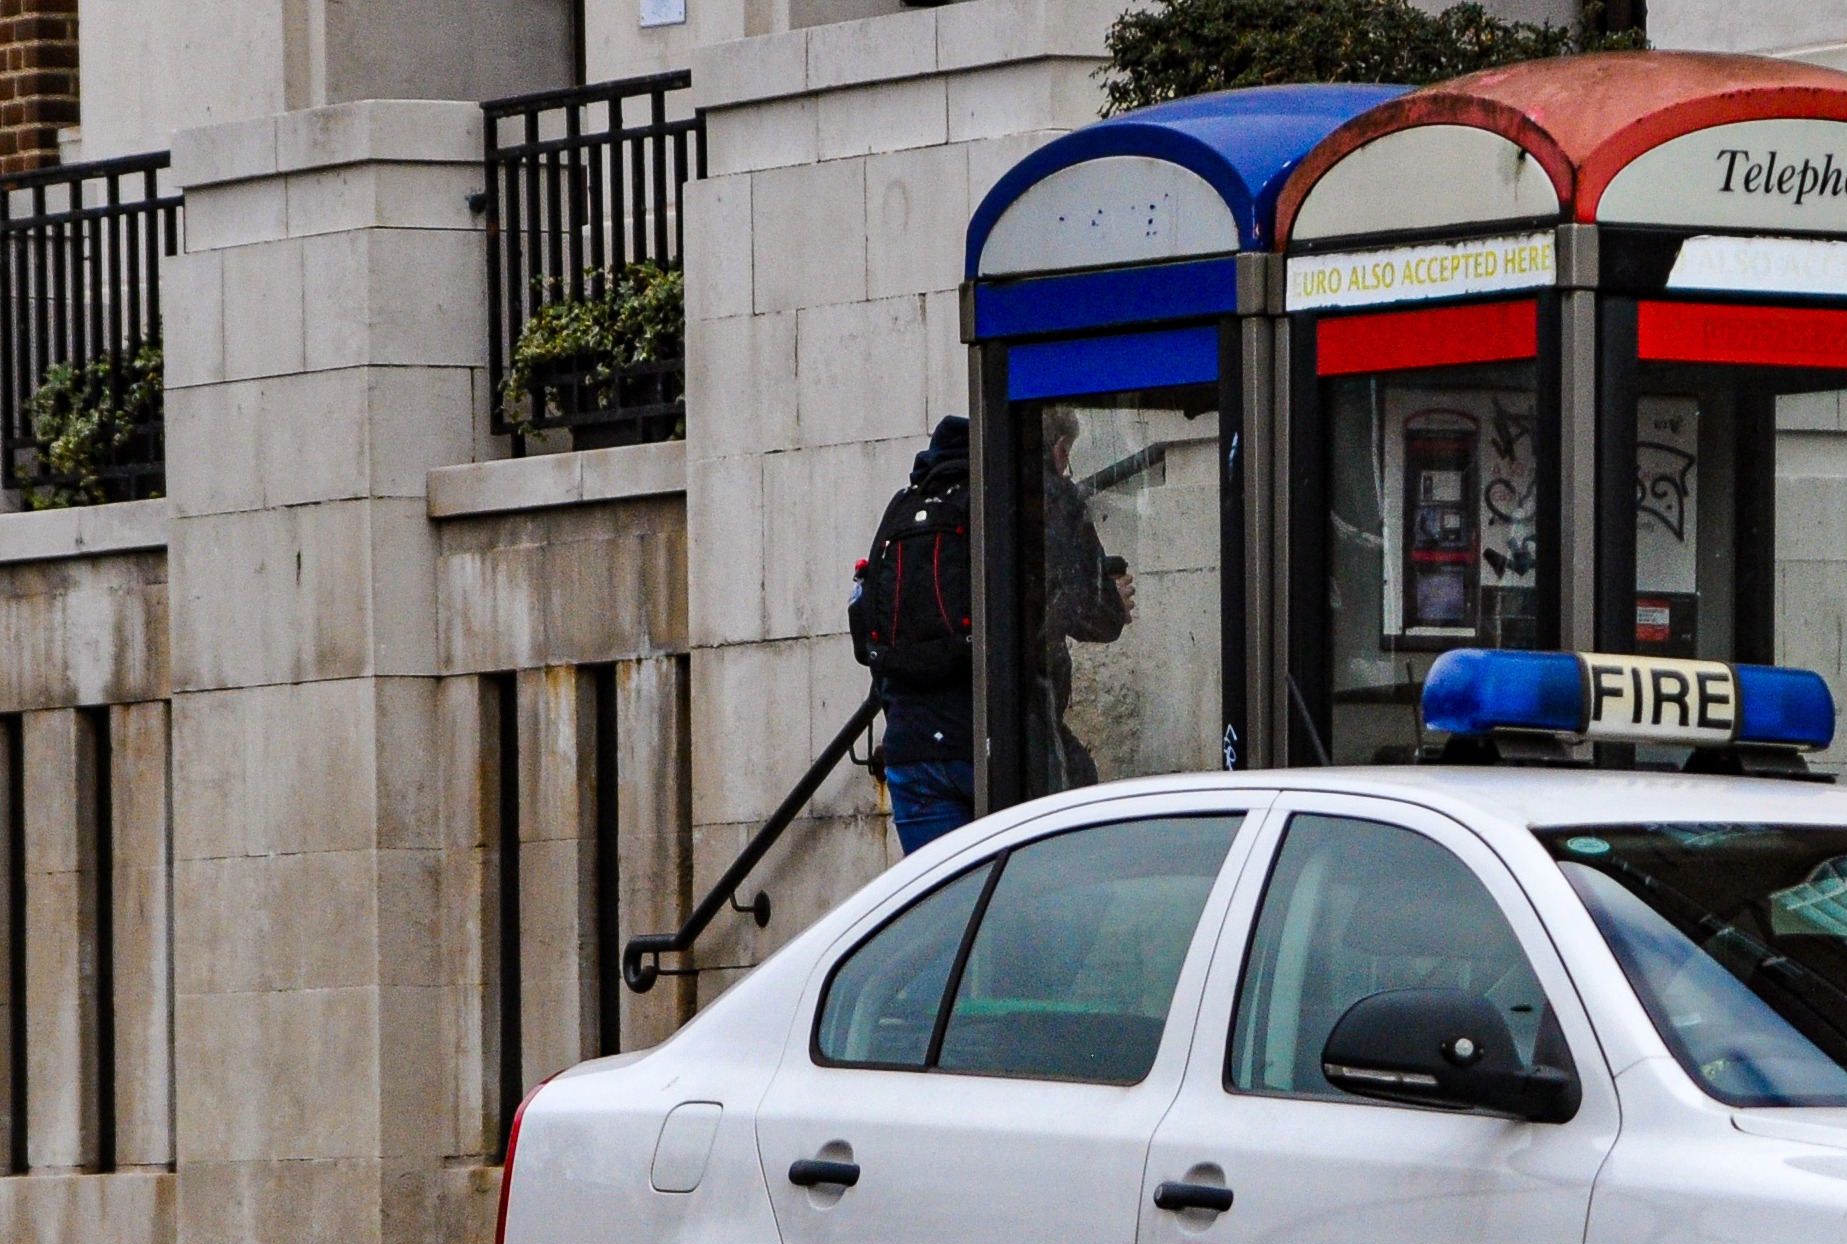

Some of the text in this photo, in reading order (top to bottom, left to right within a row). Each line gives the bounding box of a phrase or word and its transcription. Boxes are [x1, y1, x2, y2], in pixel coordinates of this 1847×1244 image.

[1347, 261, 1396, 292] ALSO
[1401, 250, 1498, 287] ACCEPTED
[1504, 243, 1551, 275] HERE
[1591, 664, 1733, 731] FIRE
